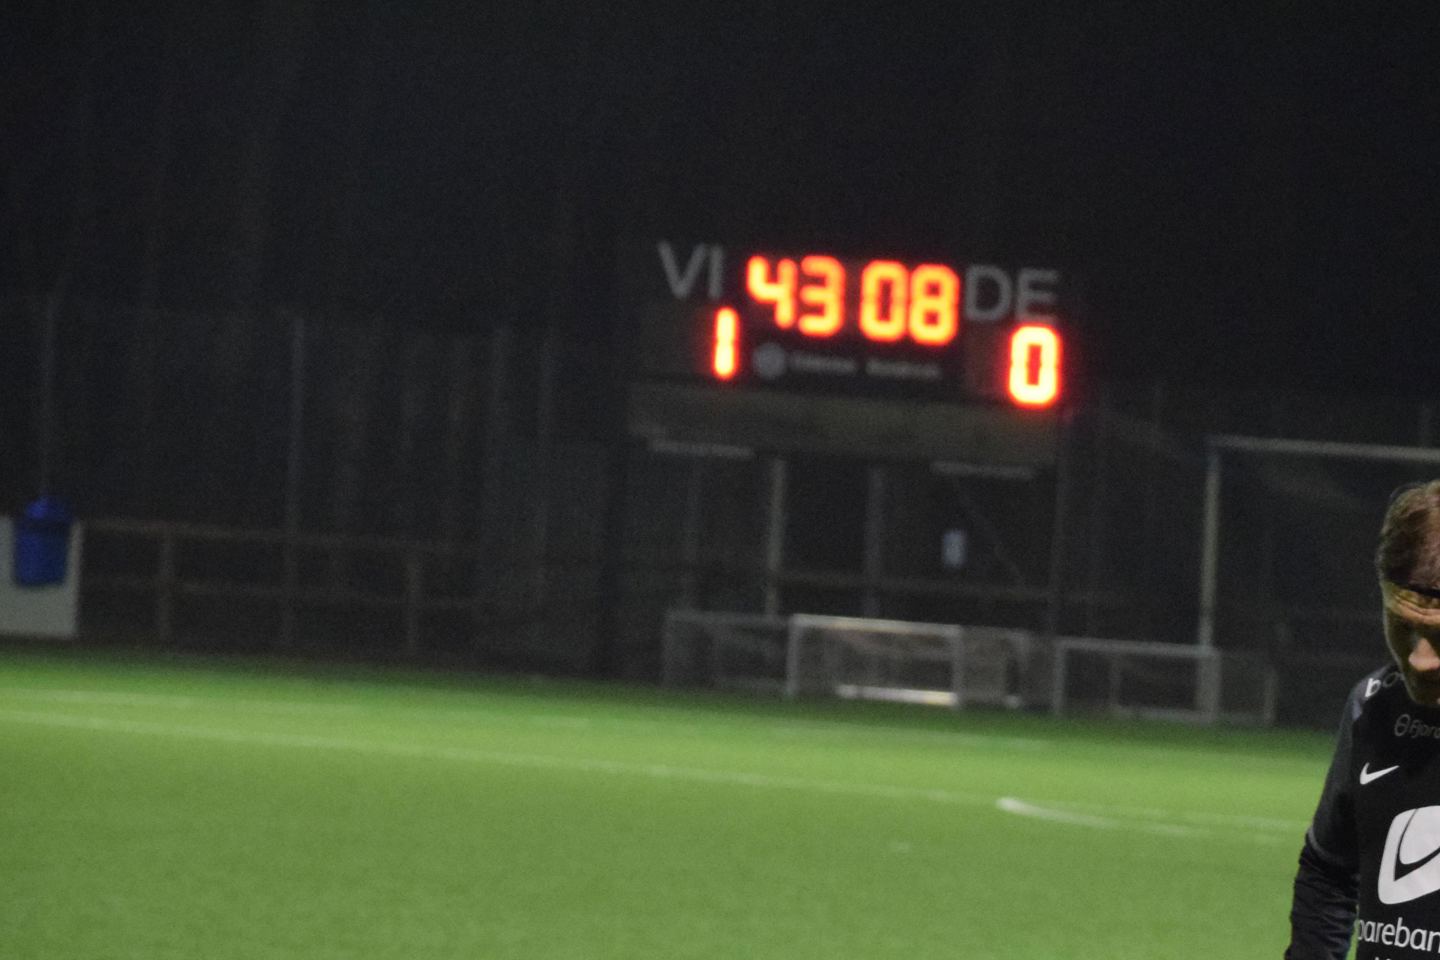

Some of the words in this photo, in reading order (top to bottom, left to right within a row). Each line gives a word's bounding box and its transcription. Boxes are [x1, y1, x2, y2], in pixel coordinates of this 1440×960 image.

[658, 241, 724, 299] VI
[745, 254, 847, 339] 43
[857, 258, 962, 346] 08
[964, 263, 1060, 325] DE
[1006, 324, 1062, 408] 0
